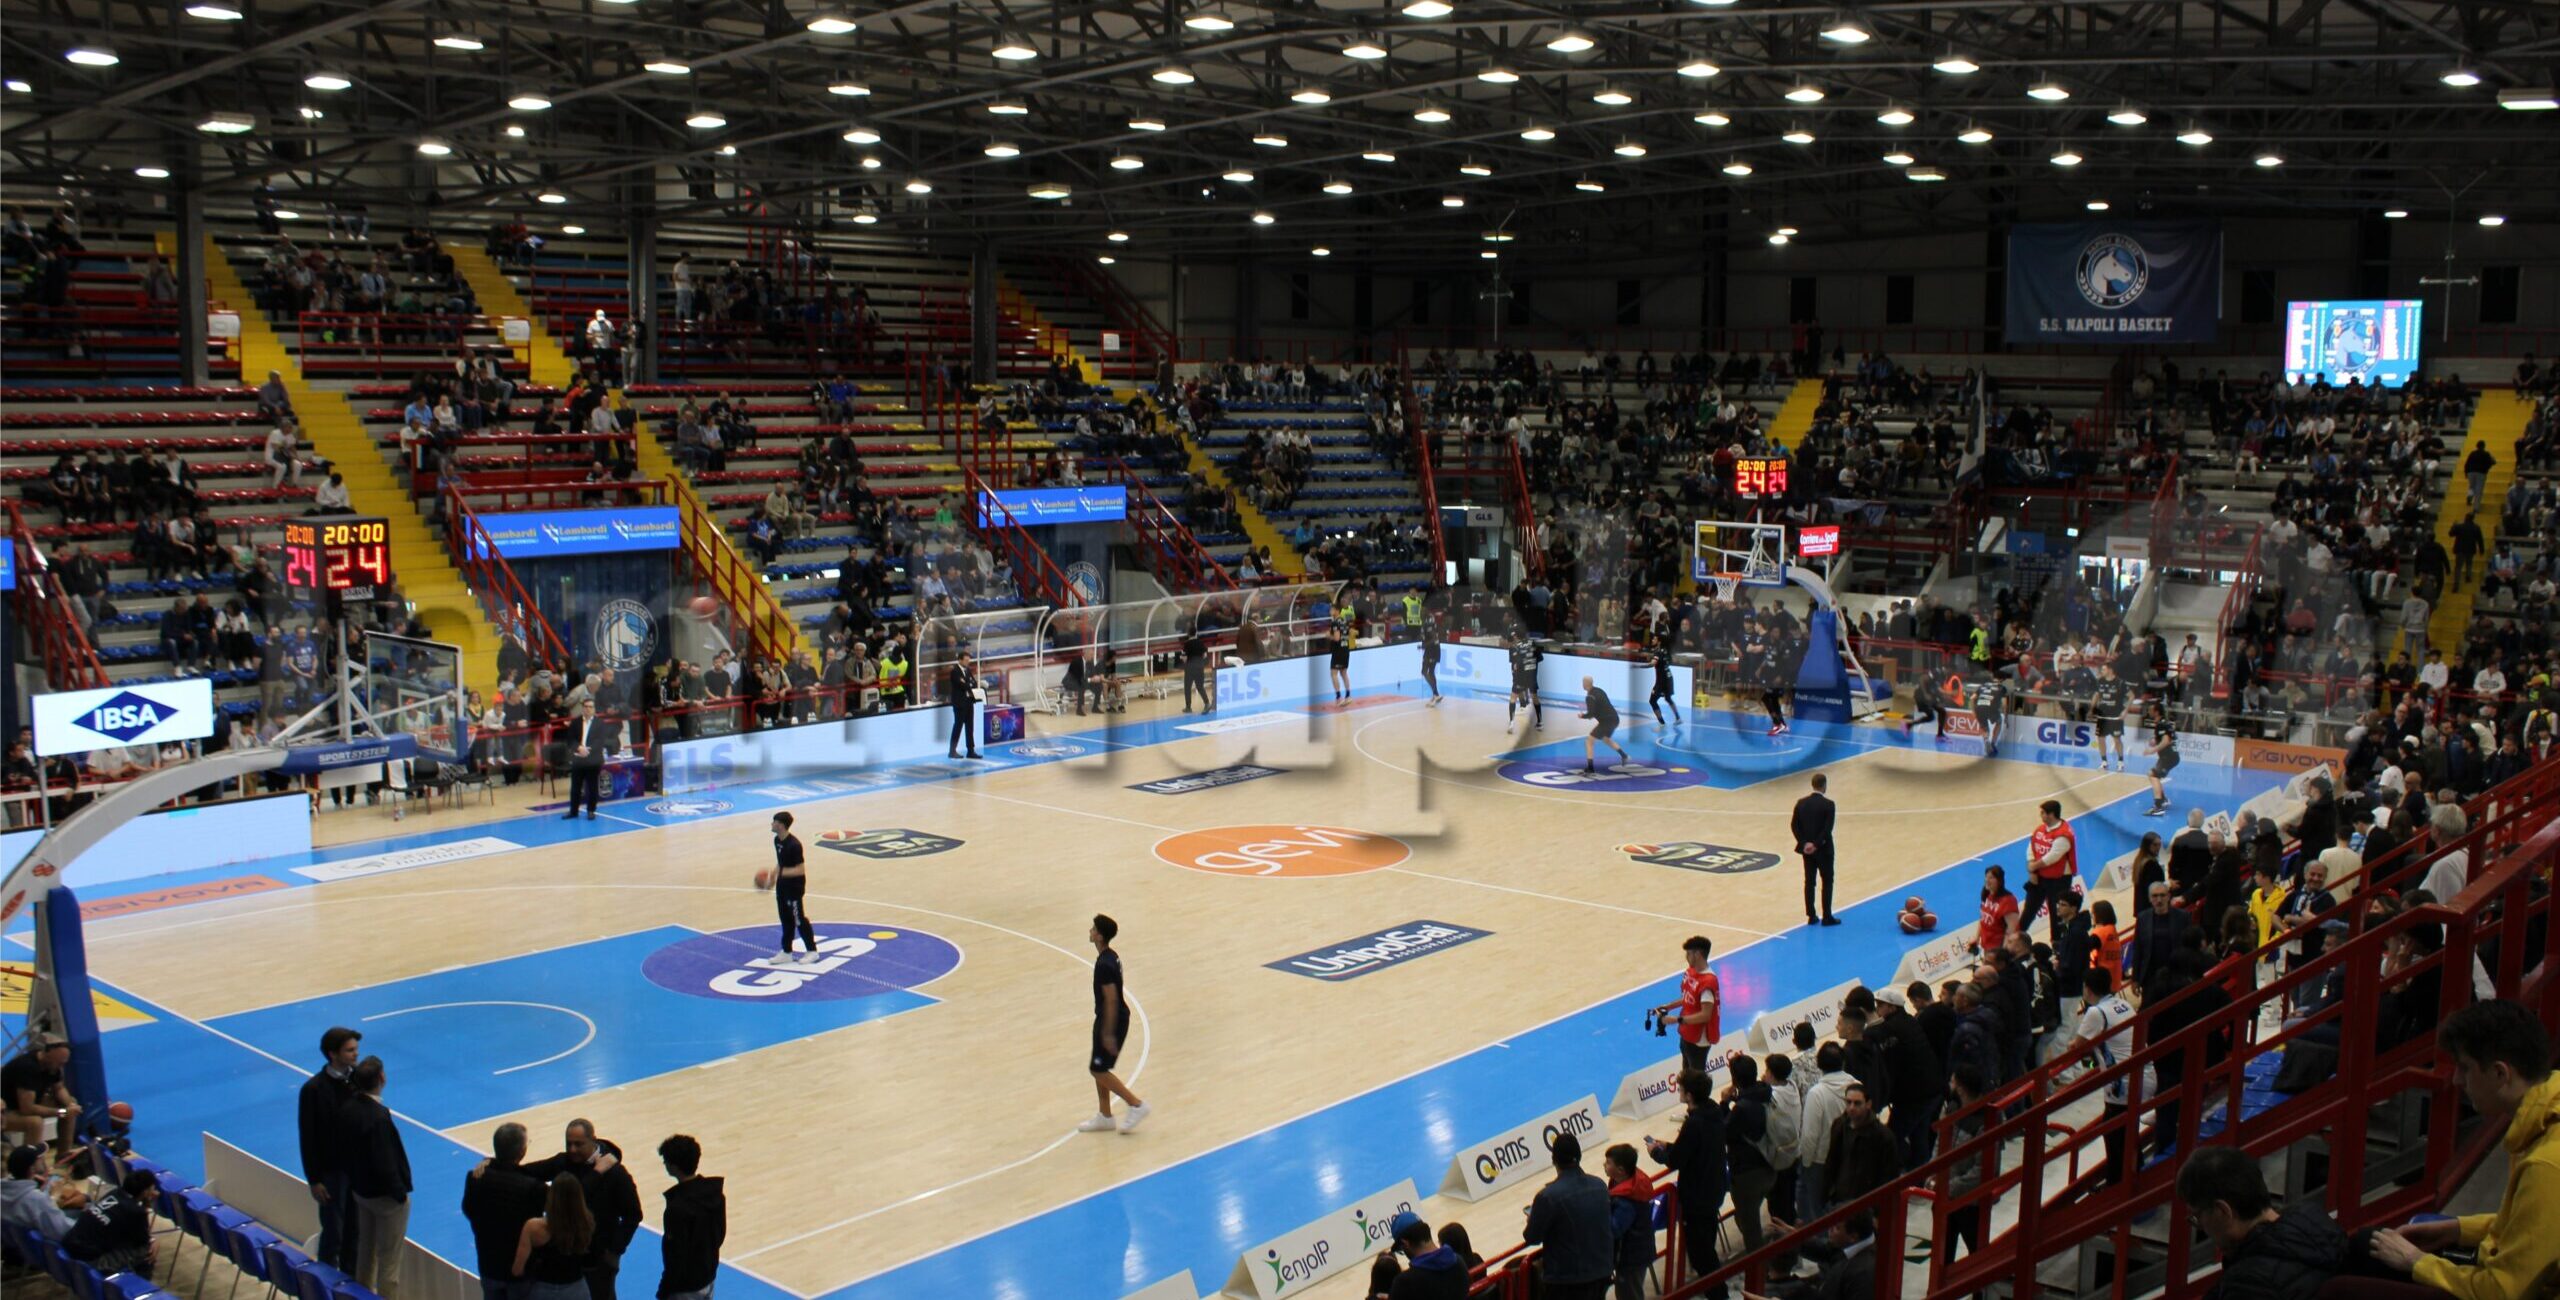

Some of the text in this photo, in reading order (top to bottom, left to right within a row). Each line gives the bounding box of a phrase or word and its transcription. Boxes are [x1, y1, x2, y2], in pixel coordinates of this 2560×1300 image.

[2040, 318, 2173, 331] S.S. NAPOLI BASKET
[1737, 460, 1766, 472] 20:00
[1737, 472, 1766, 493] 24
[1769, 471, 1787, 493] 24
[629, 521, 676, 531] Lombardi
[1475, 513, 1494, 521] GLS
[286, 524, 315, 547] 20:00
[323, 523, 385, 546] 20:00
[558, 524, 608, 536] Lombardi
[286, 546, 317, 588] 24
[325, 546, 382, 587] 24
[1441, 648, 1473, 678] LS
[1217, 669, 1262, 702] GLS
[93, 706, 159, 732] IBSA
[1947, 714, 1981, 735] gevi
[2036, 721, 2091, 747] GLS
[663, 742, 733, 789] GLS
[2265, 750, 2339, 770] GIVOVA
[1523, 763, 1667, 785] GLS
[856, 837, 945, 856] LBA
[1194, 825, 1372, 876] gevi
[1682, 850, 1755, 869] LBA
[92, 880, 267, 914] GIVOVA
[1291, 924, 1460, 972] UnipolSai
[709, 935, 878, 997] GLS
[1811, 1006, 1832, 1025] MSC
[1777, 1018, 1798, 1039] MSC
[1493, 1136, 1531, 1171] RMS
